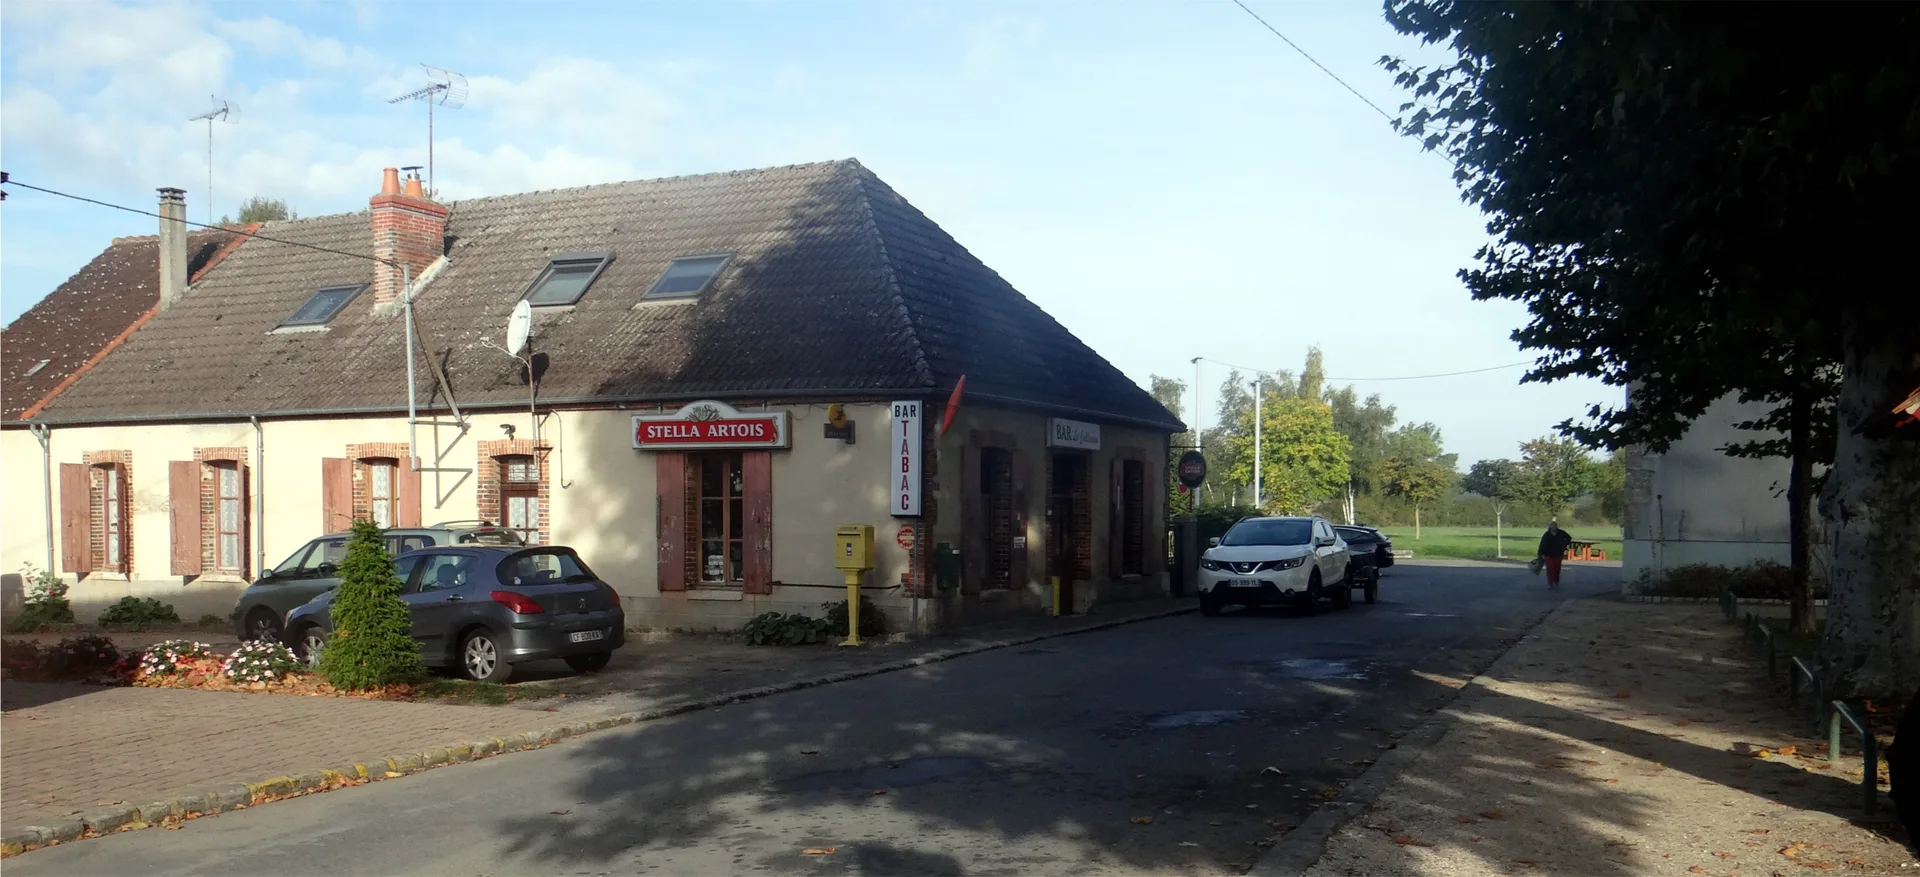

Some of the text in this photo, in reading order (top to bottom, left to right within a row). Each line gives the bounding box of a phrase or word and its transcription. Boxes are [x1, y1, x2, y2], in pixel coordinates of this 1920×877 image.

[894, 405, 917, 418] BAR
[647, 423, 764, 439] STELLA ARTOIS
[1056, 423, 1072, 441] BAR
[901, 420, 909, 511] TABAC
